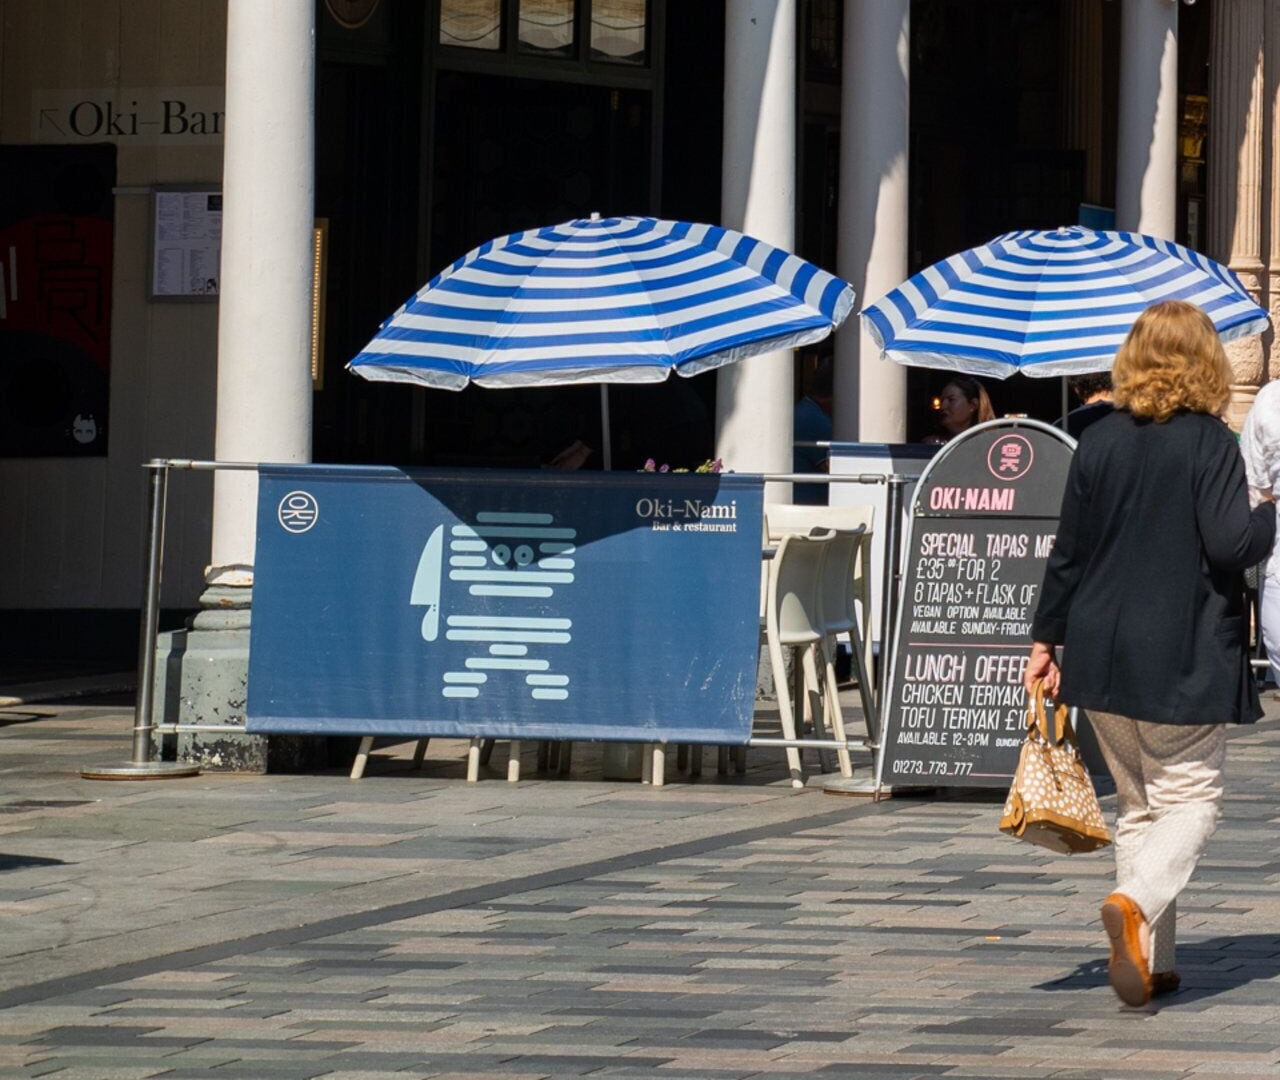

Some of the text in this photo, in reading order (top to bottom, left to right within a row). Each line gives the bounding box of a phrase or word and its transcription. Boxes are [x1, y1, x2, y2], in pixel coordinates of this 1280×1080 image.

[636, 498, 737, 518] Oki-Nami
[652, 521, 737, 532] Bar & restaurant
[920, 533, 977, 558] SPECIAL
[986, 534, 1029, 559] TAPAS
[957, 559, 985, 581] FOR
[991, 560, 1001, 581] 2
[914, 582, 923, 603] 6
[927, 582, 964, 604] TAPAS
[975, 583, 1017, 605] FLASK
[1020, 584, 1038, 605] OF
[913, 605, 1027, 620] VEGAN OPTION AVAILABLE
[910, 621, 1033, 636] AVAILABLE SUNDAY-FRIDAY
[904, 654, 967, 682] LUNCH
[901, 684, 965, 705] CHICKEN
[969, 685, 1026, 706] TERIYAKI
[900, 706, 936, 729] TOFU
[942, 707, 1001, 730] TERIYAKI
[897, 732, 948, 745] AVAILABLE
